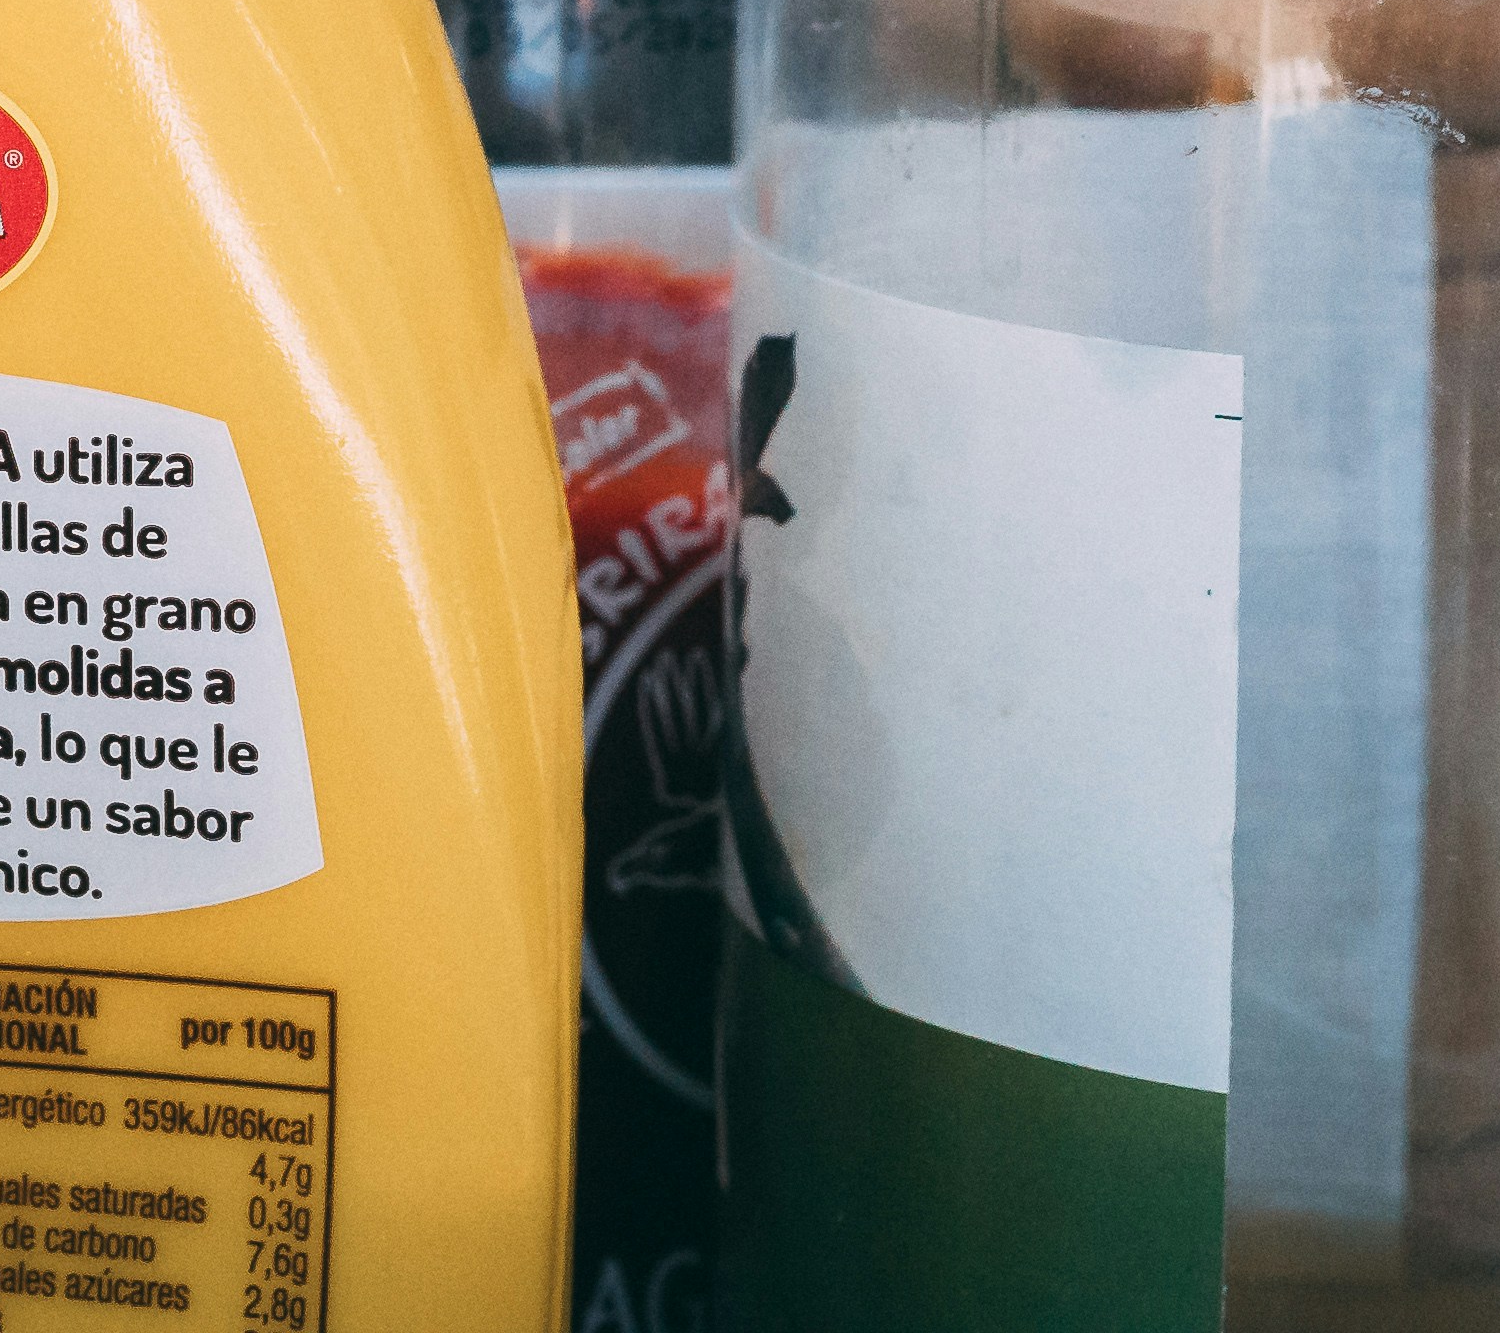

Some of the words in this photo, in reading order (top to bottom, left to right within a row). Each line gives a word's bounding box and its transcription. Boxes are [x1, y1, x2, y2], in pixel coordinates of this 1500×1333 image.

[34, 434, 193, 487] utiliza
[103, 507, 167, 558] de
[25, 591, 87, 625] en
[102, 593, 255, 641] grano
[204, 669, 234, 704] a
[41, 713, 85, 763] lo
[100, 734, 198, 780] que
[214, 724, 258, 775] le
[27, 797, 91, 831] un
[106, 789, 253, 842] sabor
[181, 1018, 232, 1049] por
[241, 1018, 315, 1060] 100g
[124, 1098, 314, 1145] 359kJ/86kcal
[250, 1153, 313, 1197] 4,7g
[69, 1182, 206, 1223] saturadas
[249, 1196, 311, 1242] 0,3g
[2, 1217, 35, 1251] de
[44, 1224, 155, 1263] carbono
[248, 1240, 308, 1287] 7,6g
[64, 1268, 190, 1312] azúcares
[244, 1285, 306, 1331] 2,8g
